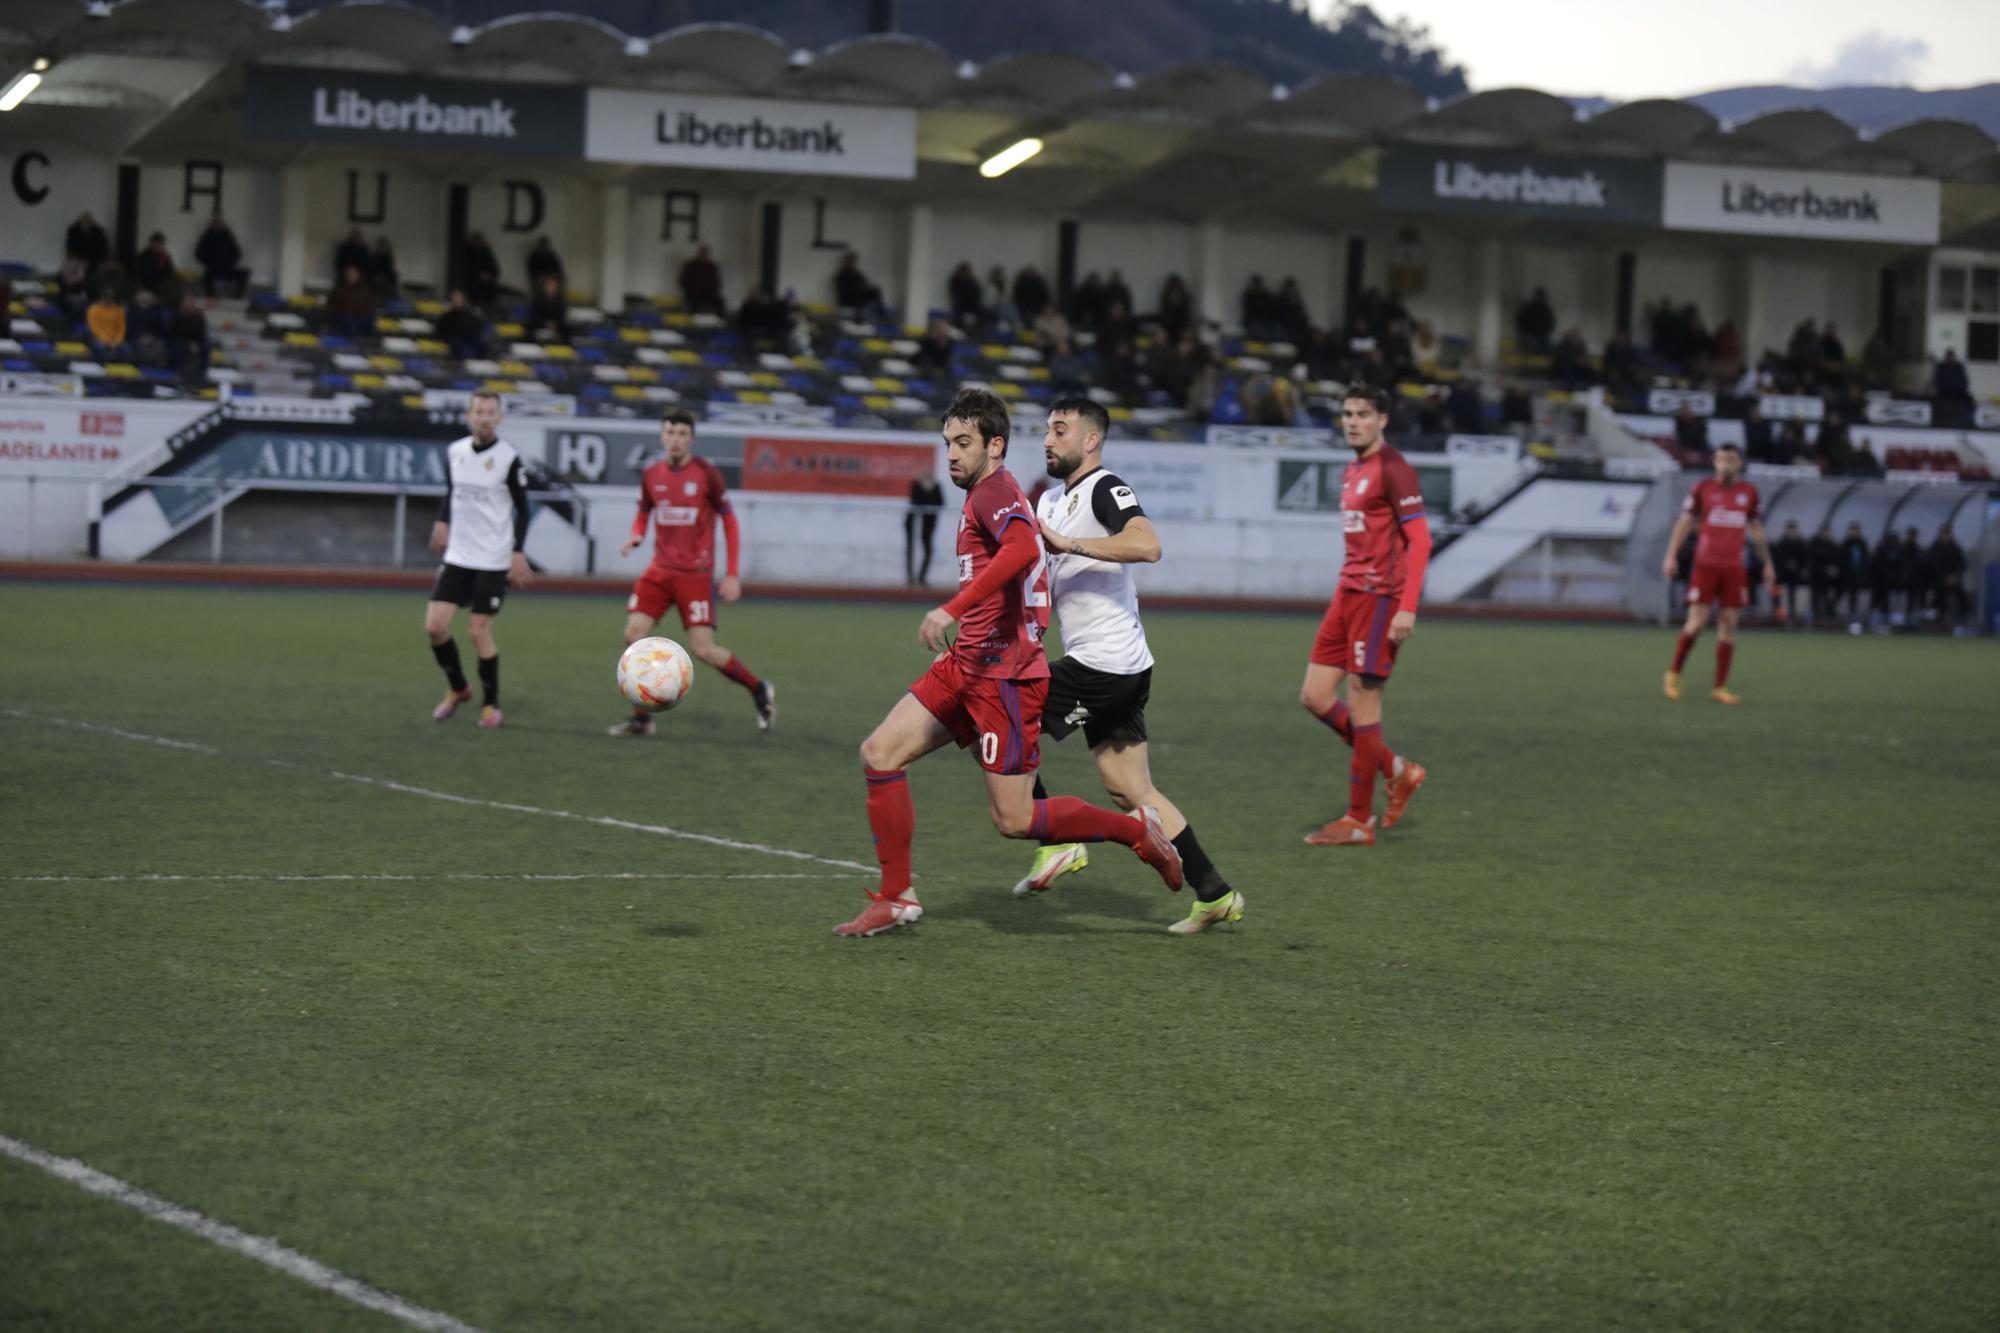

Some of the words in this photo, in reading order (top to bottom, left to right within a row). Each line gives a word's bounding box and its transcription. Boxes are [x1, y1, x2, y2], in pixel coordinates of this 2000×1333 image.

[313, 87, 517, 137] Liberbank
[656, 110, 845, 155] Liberbank
[1434, 160, 1607, 207] Liberbank
[1721, 179, 1881, 222] Liberbank
[1024, 533, 1051, 607] 2
[689, 600, 709, 624] 31
[1354, 640, 1366, 667] 5
